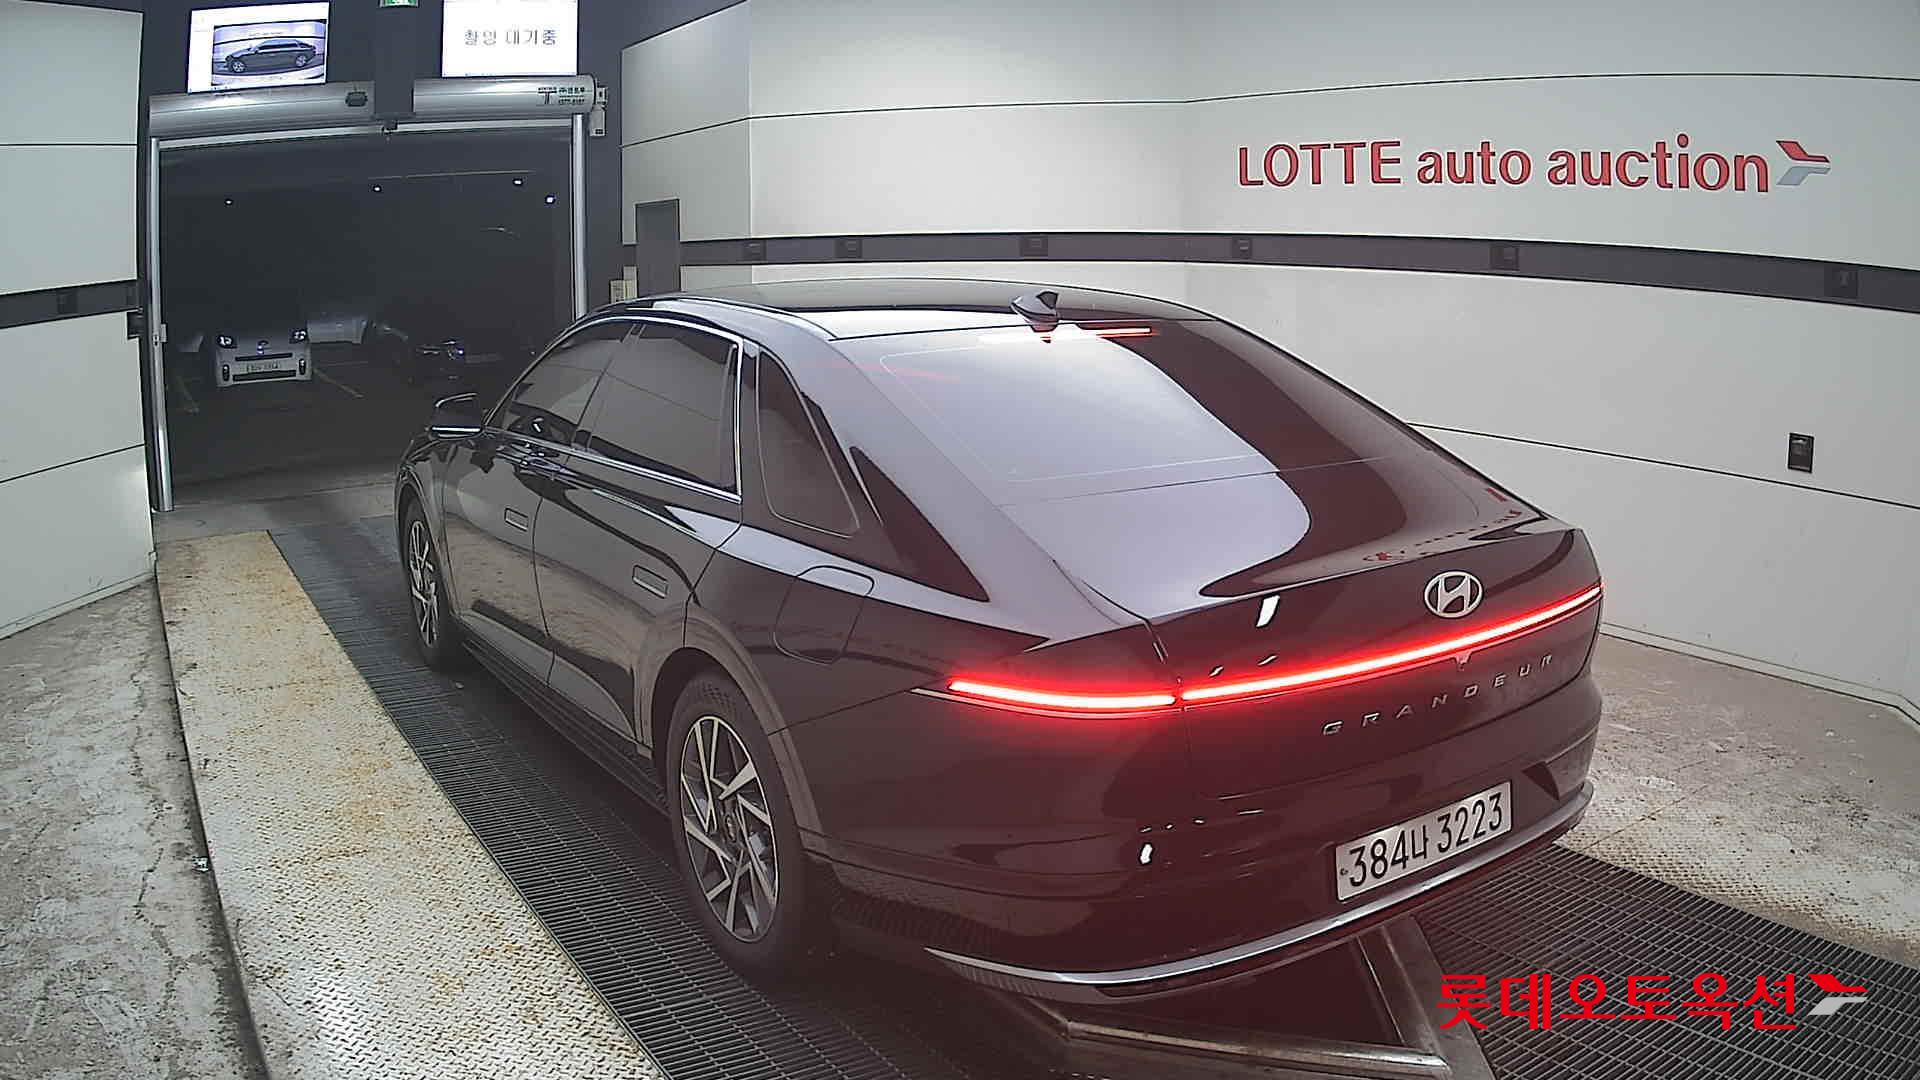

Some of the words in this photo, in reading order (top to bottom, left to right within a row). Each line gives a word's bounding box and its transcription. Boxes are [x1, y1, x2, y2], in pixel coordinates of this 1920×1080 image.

[505, 29, 557, 46] 대기중
[1239, 140, 1401, 187] LOTTE
[1416, 141, 1532, 186] auto
[1546, 134, 1769, 192] auction
[1322, 654, 1553, 736] GRANDEUR
[1437, 792, 1502, 853] 3223
